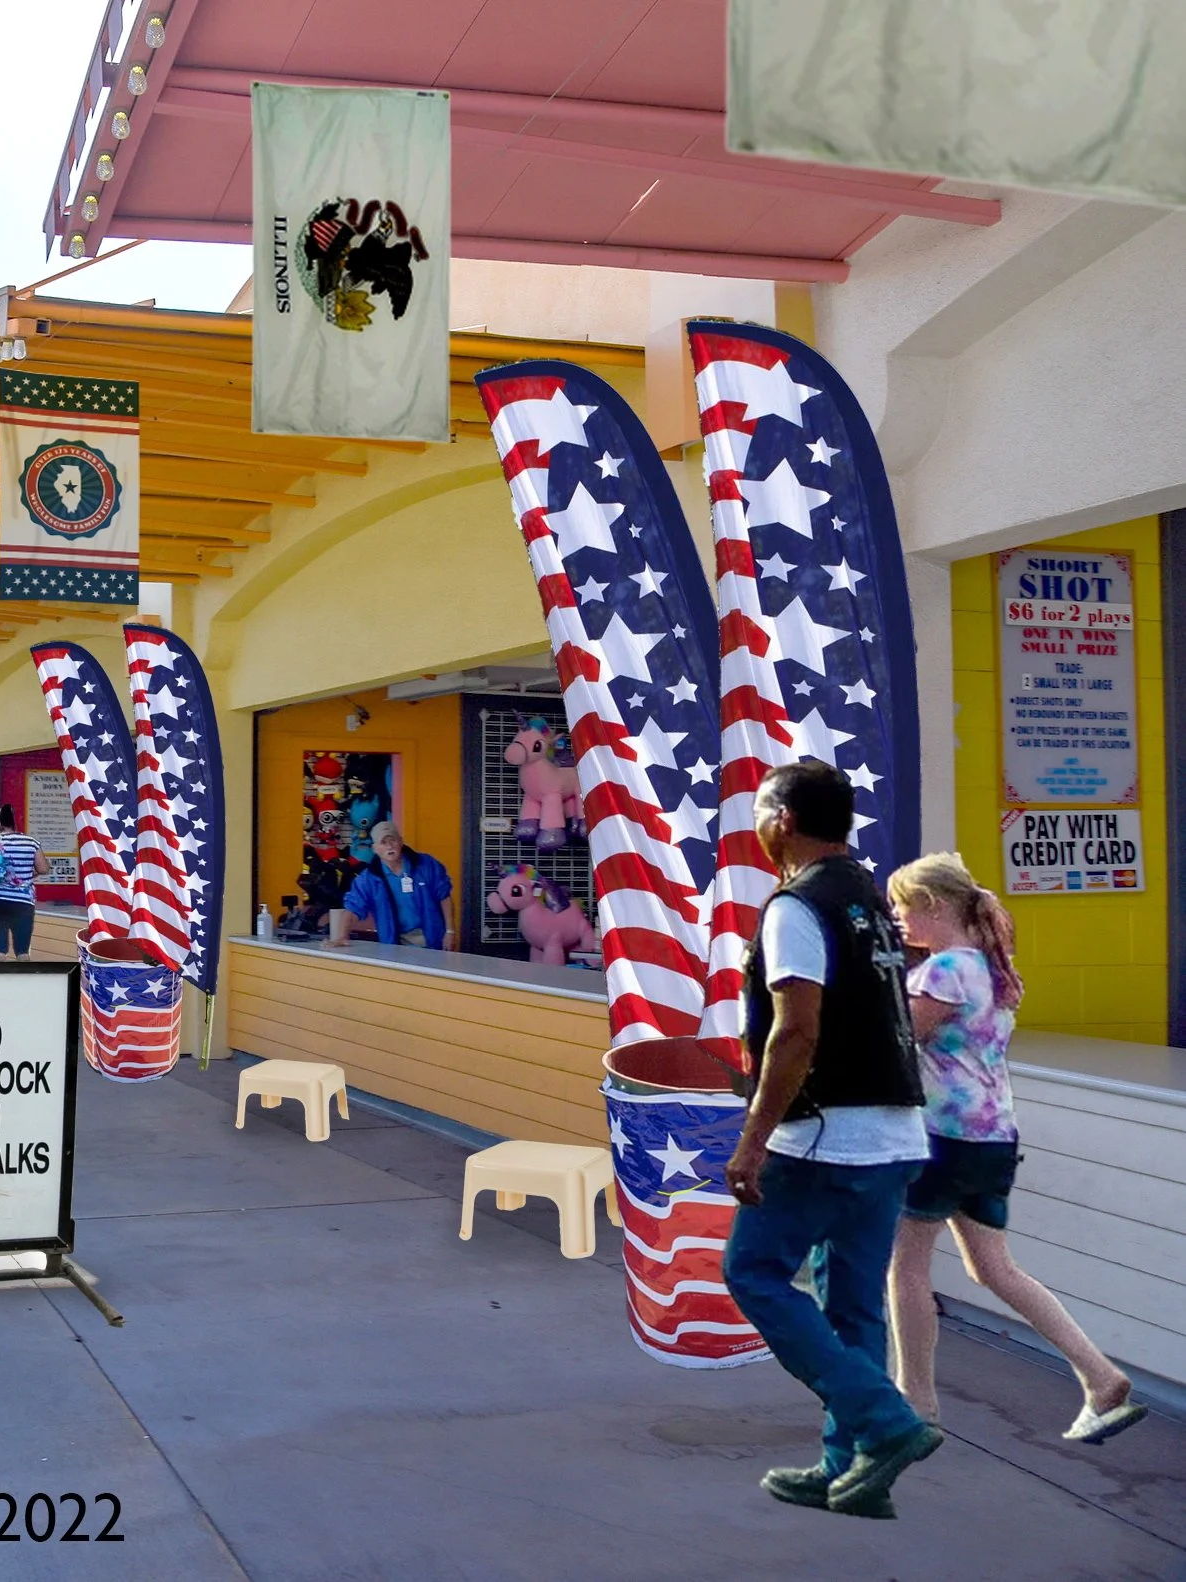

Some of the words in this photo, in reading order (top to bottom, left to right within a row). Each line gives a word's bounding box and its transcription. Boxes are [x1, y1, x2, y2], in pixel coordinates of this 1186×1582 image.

[274, 216, 290, 313] ILLINOIS
[35, 452, 53, 469] OVER
[54, 447, 68, 455] 175
[70, 448, 97, 463] YEARS
[96, 462, 107, 473] OF
[30, 492, 71, 530] WHOLESOME
[74, 514, 102, 530] FAMILY
[101, 498, 111, 514] FUN
[1027, 558, 1102, 574] SHORT
[1020, 574, 1112, 602] SHOT
[1009, 602, 1034, 620] $6
[1042, 606, 1065, 620] for
[1069, 604, 1080, 621] 2
[1088, 608, 1130, 627] plays
[1022, 628, 1050, 639] ONE
[1059, 629, 1073, 640] IN
[1082, 630, 1116, 641] WINS
[1022, 642, 1068, 654] SMALL
[1077, 644, 1118, 656] PRIZE
[1034, 678, 1060, 688] SMALL
[1062, 678, 1078, 689] FOR
[1088, 680, 1112, 690] LARGE
[1017, 738, 1031, 748] CAN
[1034, 739, 1041, 748] BE
[1072, 740, 1078, 748] AT
[1081, 740, 1096, 748] THIS
[1098, 740, 1130, 750] LOCATION
[1024, 814, 1060, 840] PAY
[1066, 814, 1118, 838] WITH
[1010, 841, 1076, 866] CREDIT
[1084, 840, 1136, 865] CARD
